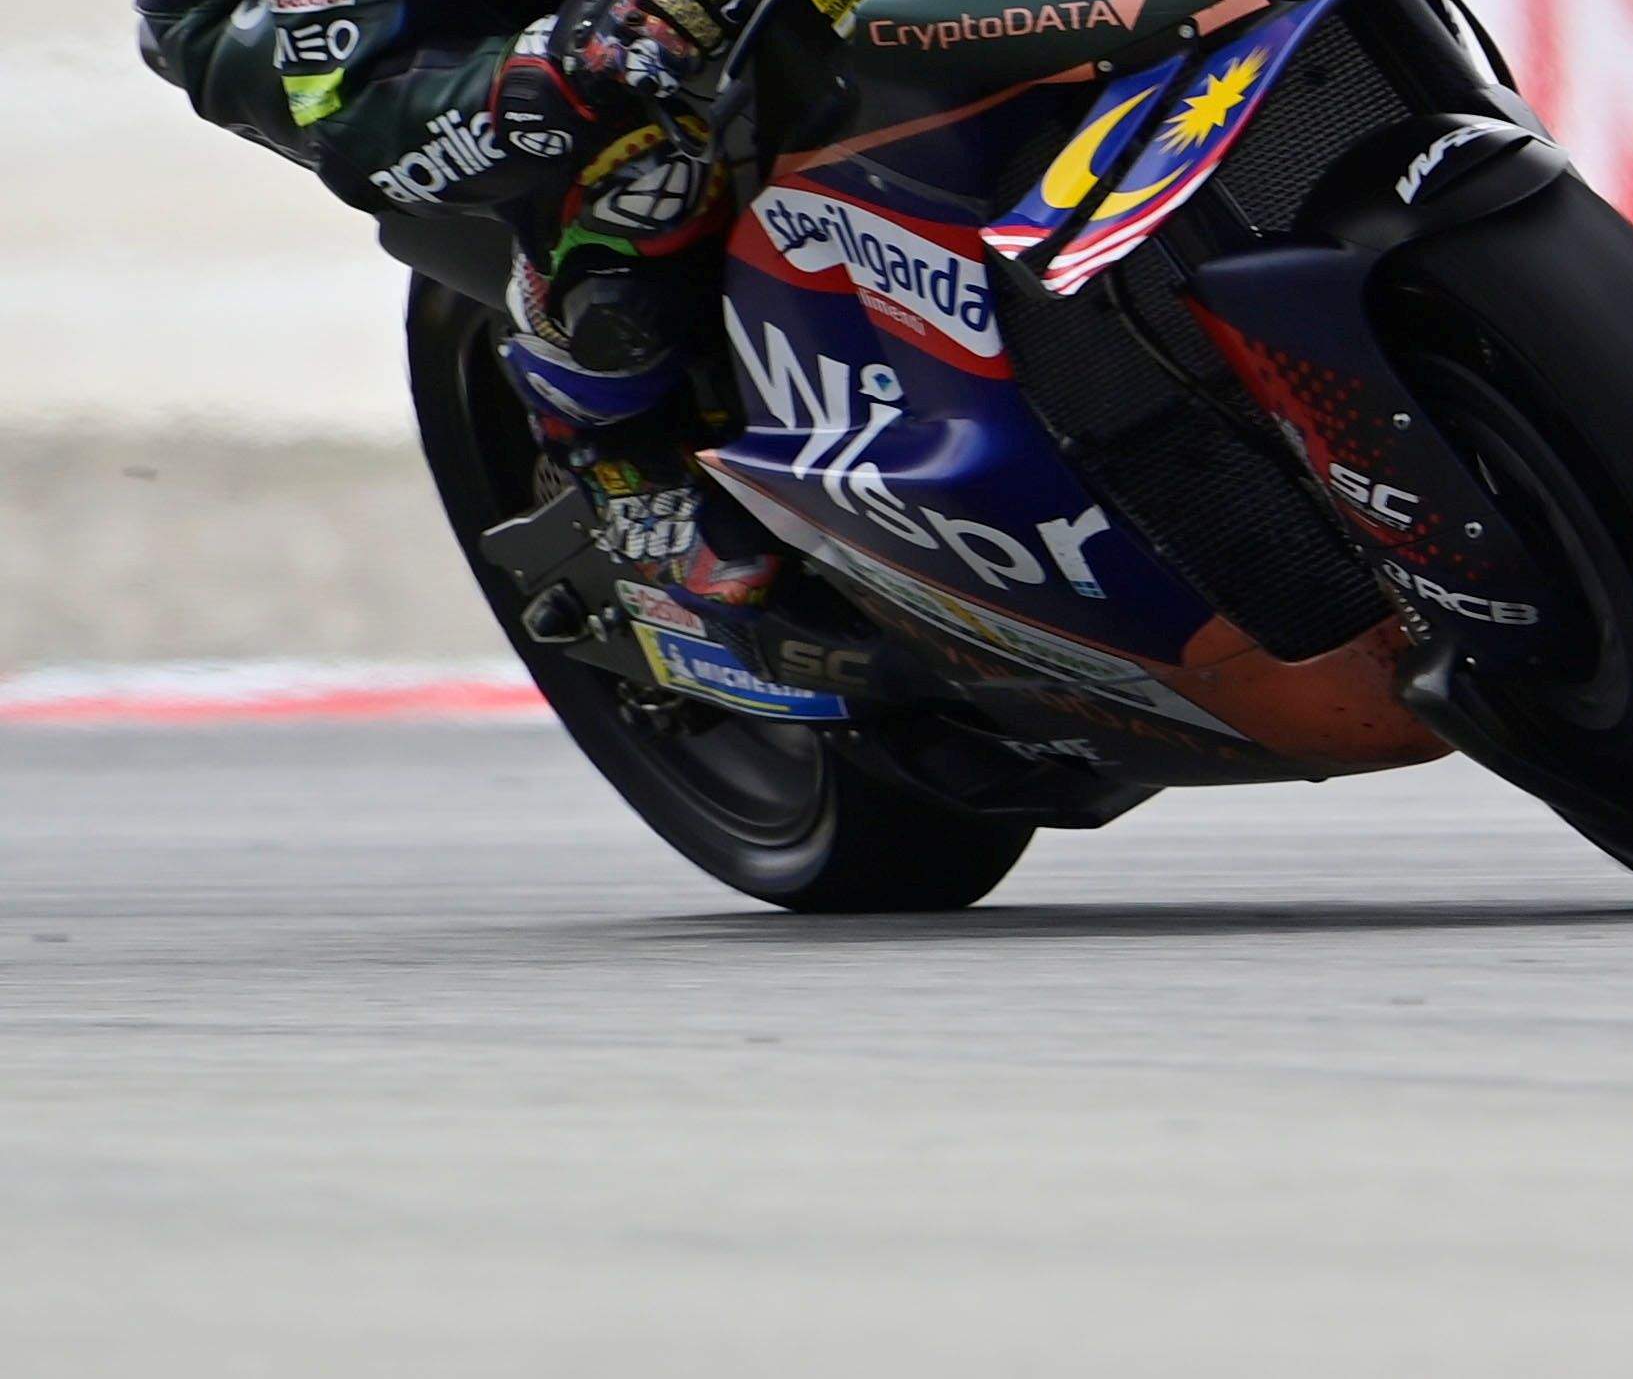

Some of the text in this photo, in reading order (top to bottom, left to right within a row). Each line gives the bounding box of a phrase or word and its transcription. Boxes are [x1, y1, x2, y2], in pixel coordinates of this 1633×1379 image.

[367, 107, 508, 204] aprilia
[765, 200, 997, 333] sterilgarda
[723, 294, 1110, 599] Wispr
[1329, 462, 1420, 525] SC
[780, 640, 873, 686] SC
